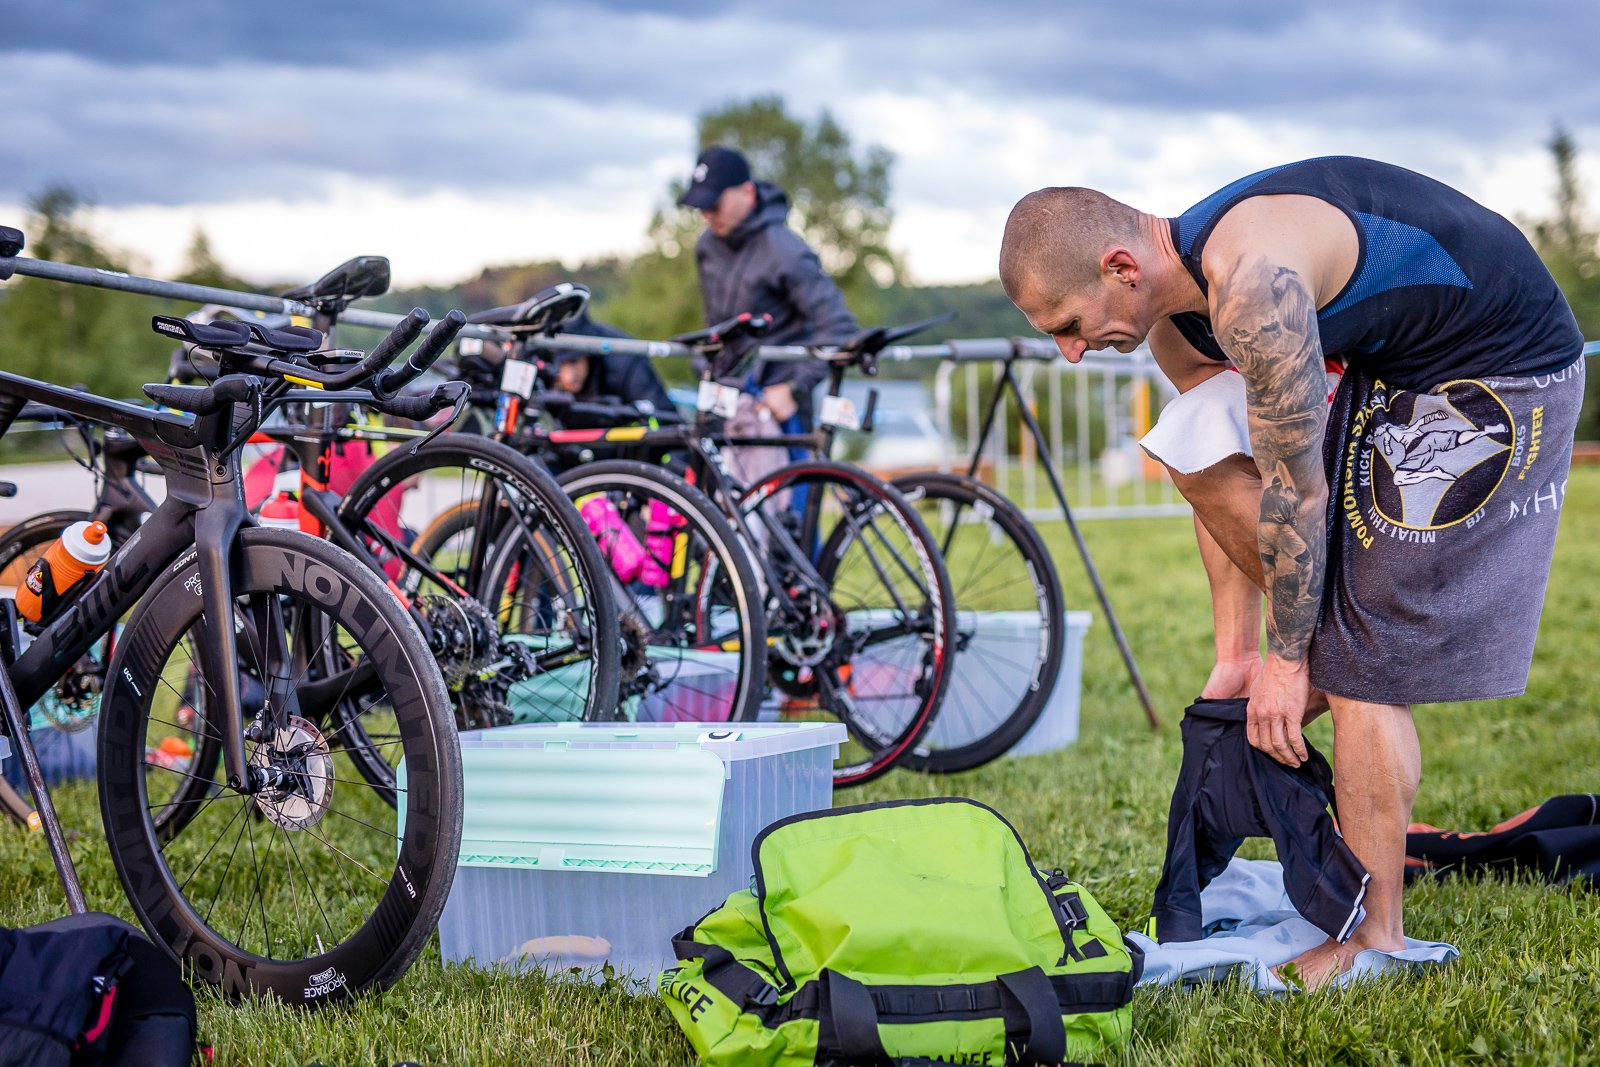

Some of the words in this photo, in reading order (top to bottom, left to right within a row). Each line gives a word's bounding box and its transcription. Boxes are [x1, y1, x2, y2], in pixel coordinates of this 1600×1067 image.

[1511, 424, 1526, 467] BOKS
[1518, 405, 1544, 480] FIGHTER
[1360, 449, 1371, 486] KICK
[1465, 507, 1486, 529] BJJ
[123, 667, 133, 682] UCI
[406, 882, 417, 899] UCI
[304, 972, 346, 998] PRORACE
